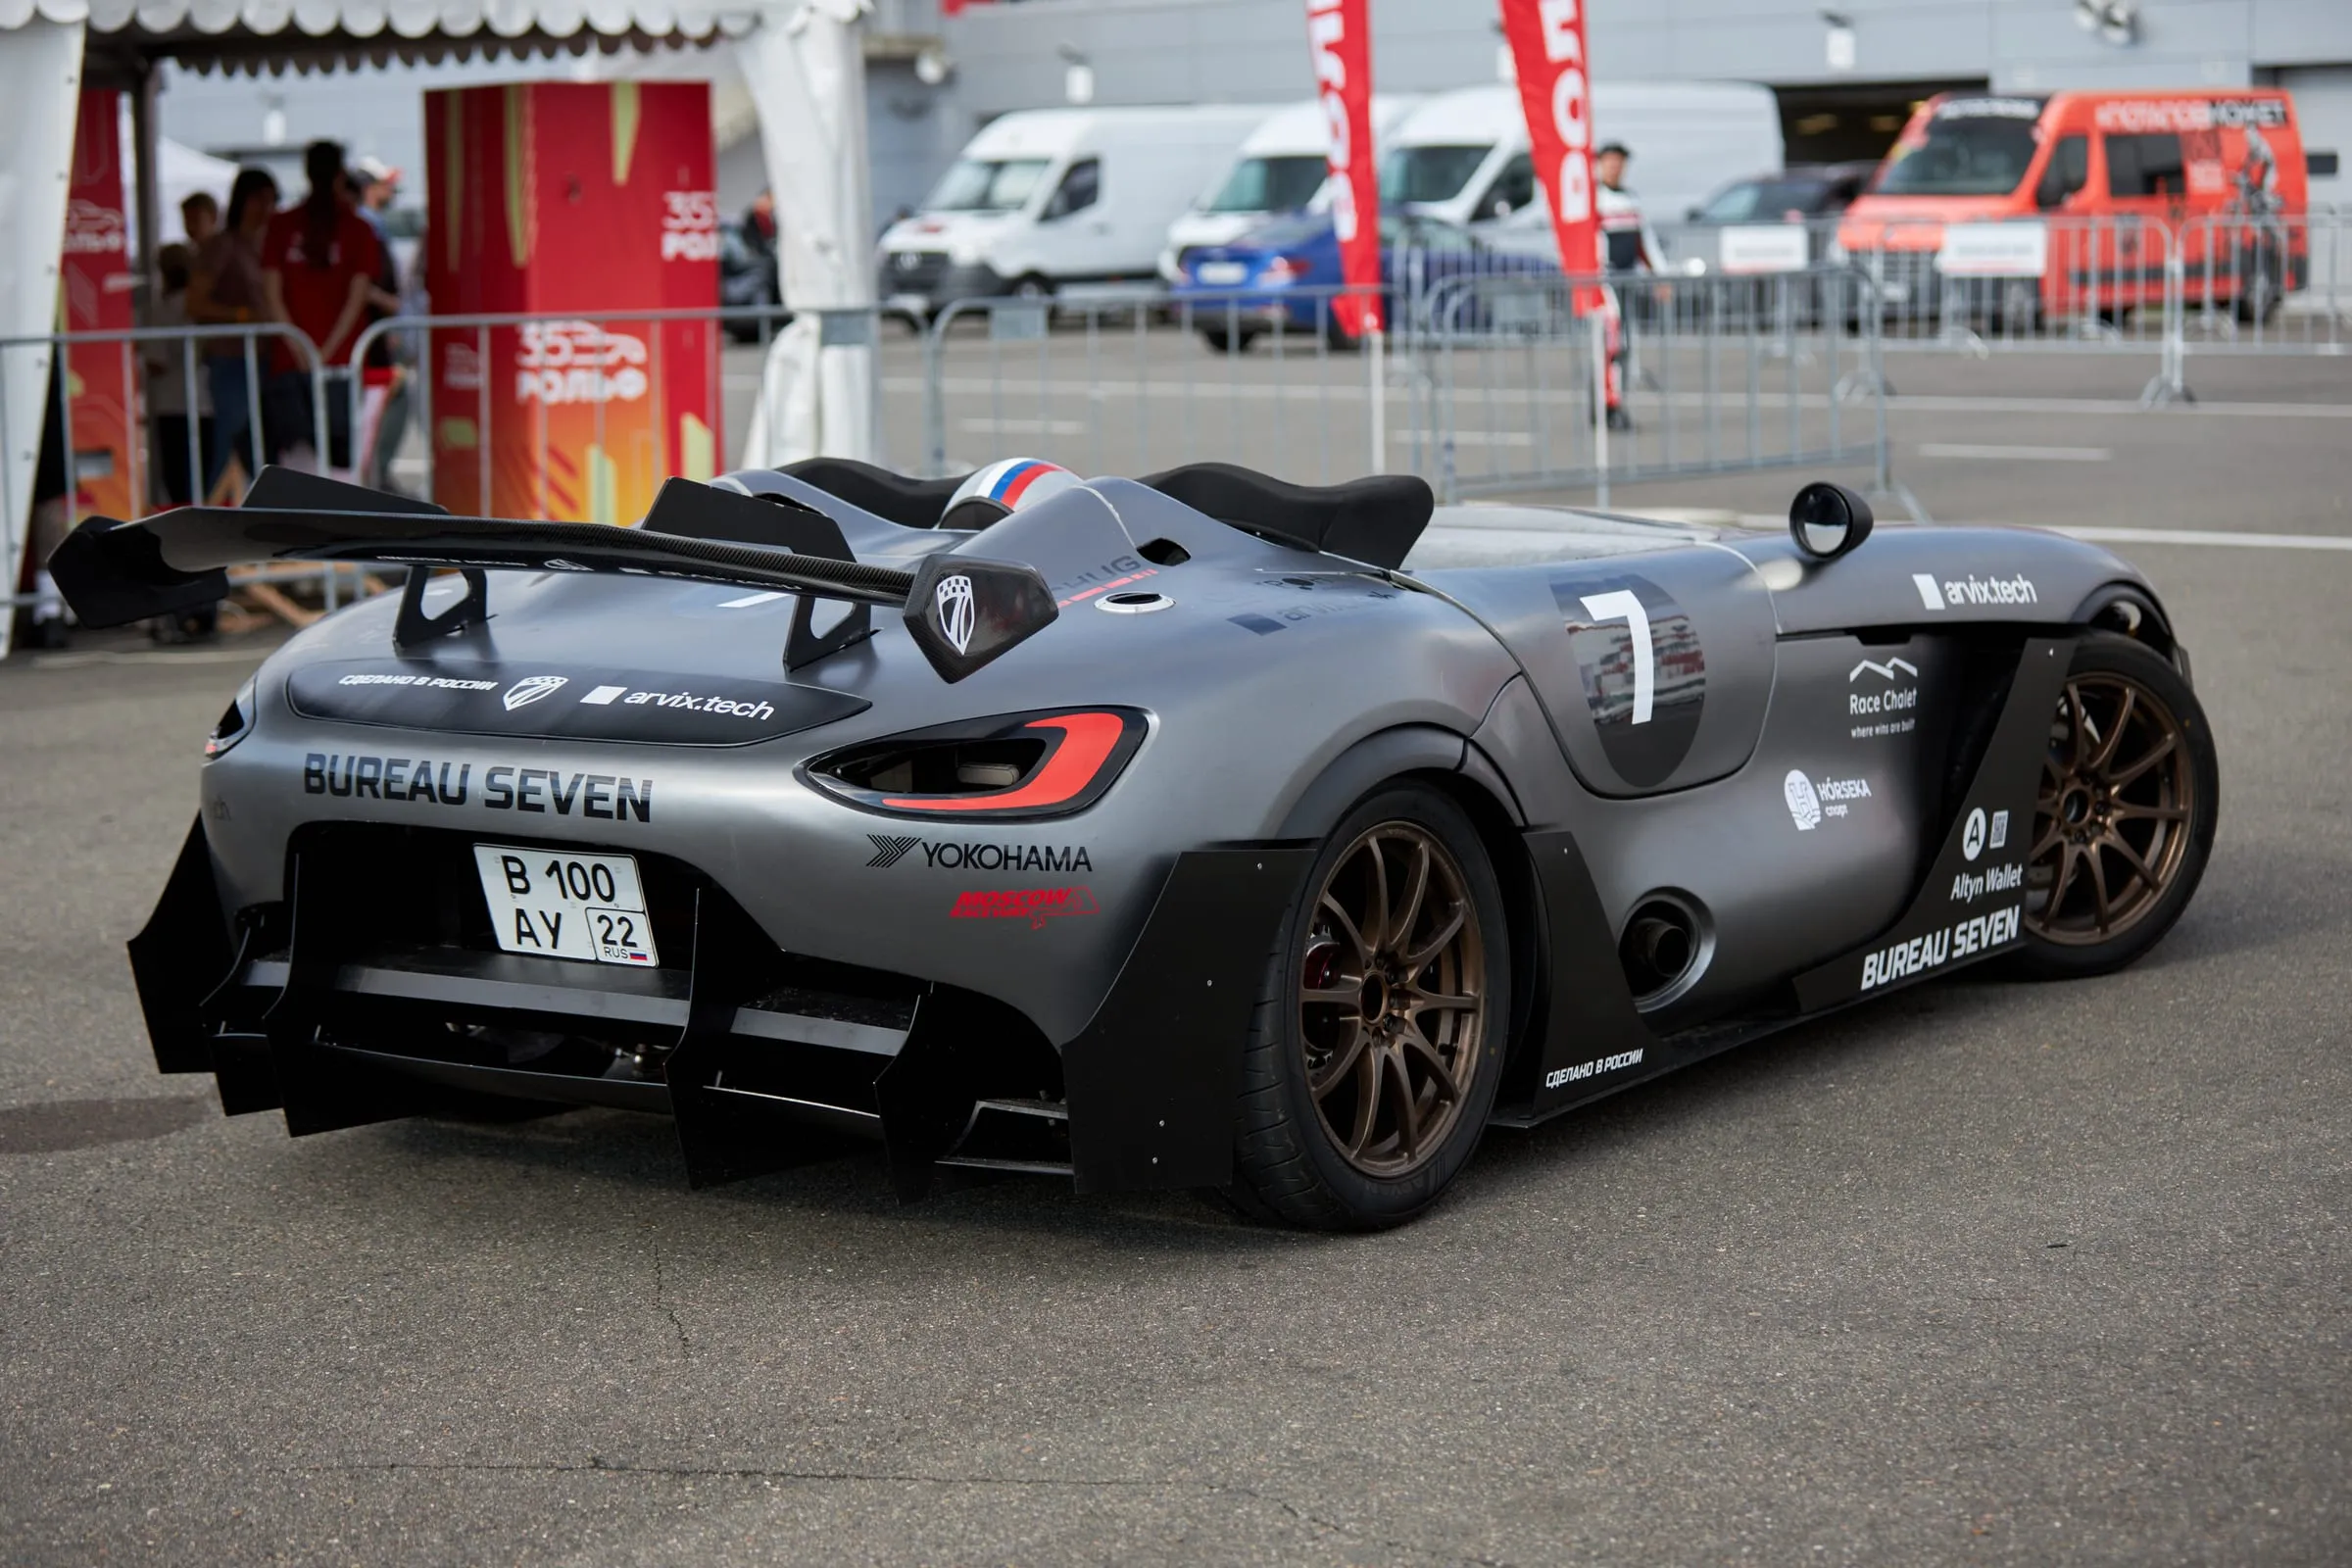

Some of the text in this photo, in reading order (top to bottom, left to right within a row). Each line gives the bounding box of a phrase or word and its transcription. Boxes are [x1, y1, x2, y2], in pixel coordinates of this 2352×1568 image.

[515, 368, 648, 407] РОЛЬФ
[1944, 573, 2038, 605] arvix.tech
[1579, 589, 1654, 725] 7
[338, 674, 499, 690] СДЕЛАНО В РОССИИ
[623, 691, 775, 720] arvix.tech
[1849, 687, 1918, 715] Race Chalet
[1850, 726, 1874, 738] where
[304, 753, 654, 823] BUREAU SEVEN
[921, 842, 1093, 872] YOKOHAMA
[545, 859, 615, 903] 100
[956, 887, 1074, 906] MOSCOW
[1949, 862, 2024, 904] Altyn Wallet
[596, 914, 638, 948] 22
[603, 946, 629, 959] RUS
[1860, 905, 2021, 992] BUREAU SEVEN
[1545, 1048, 1643, 1089] СДЕЛАНО В РОССИИ
